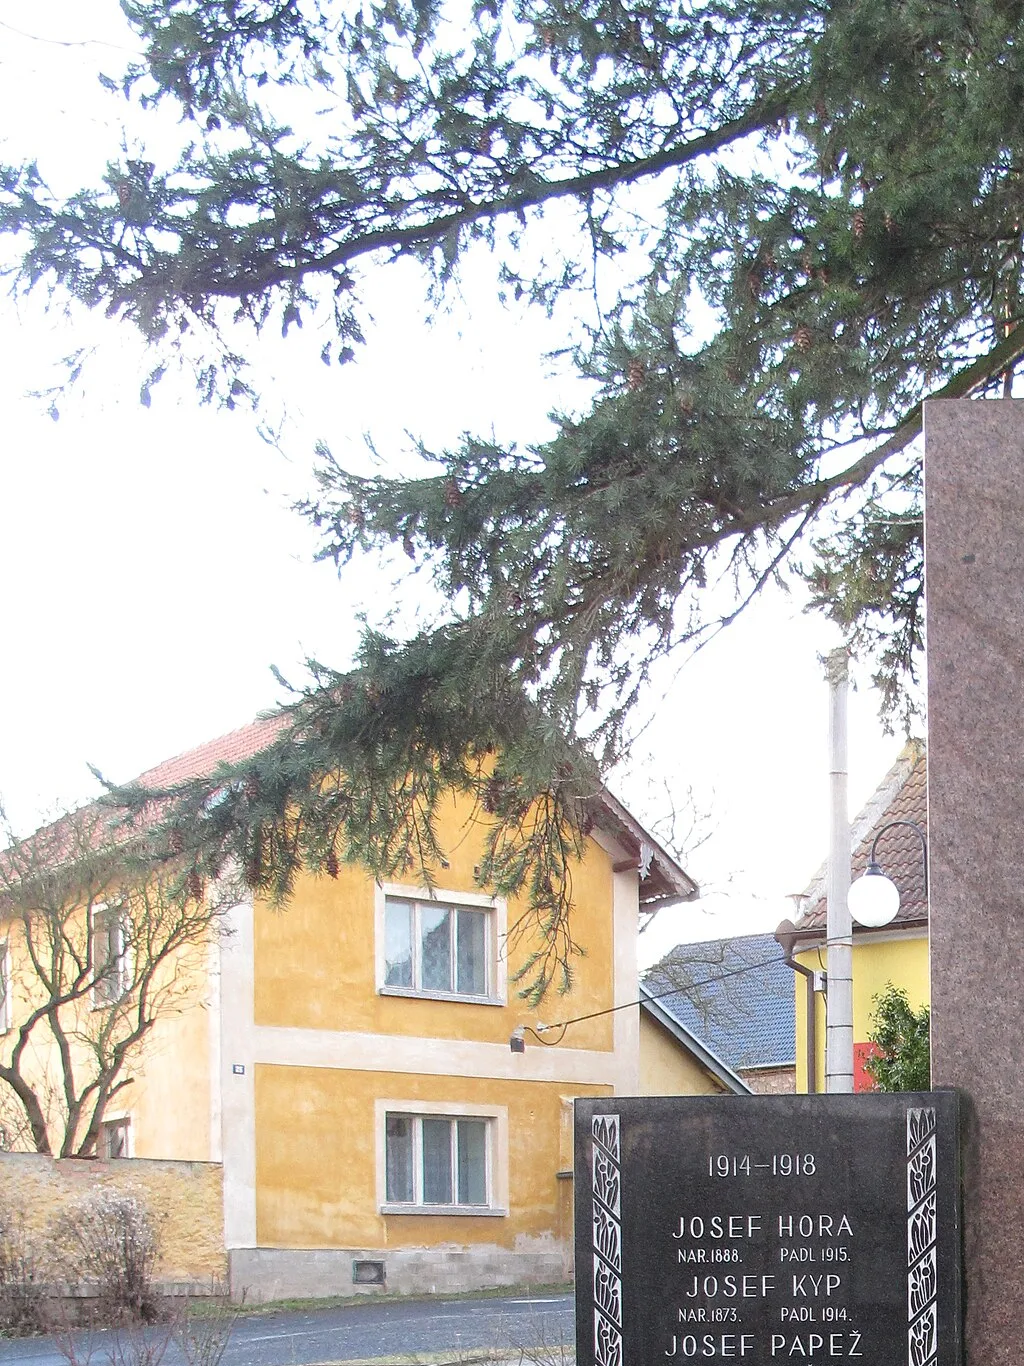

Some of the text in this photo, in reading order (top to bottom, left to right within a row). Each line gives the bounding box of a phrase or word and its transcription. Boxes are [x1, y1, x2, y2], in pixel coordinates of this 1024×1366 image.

[671, 1214, 854, 1239] JOSEF HORA
[780, 1247, 817, 1262] PADL
[821, 1246, 851, 1262] 1915.
[685, 1274, 841, 1298] JOSEF KYP
[780, 1306, 817, 1322] PADL
[822, 1306, 853, 1322] 1914.
[664, 1329, 863, 1357] JOSEF PAPEŽ
